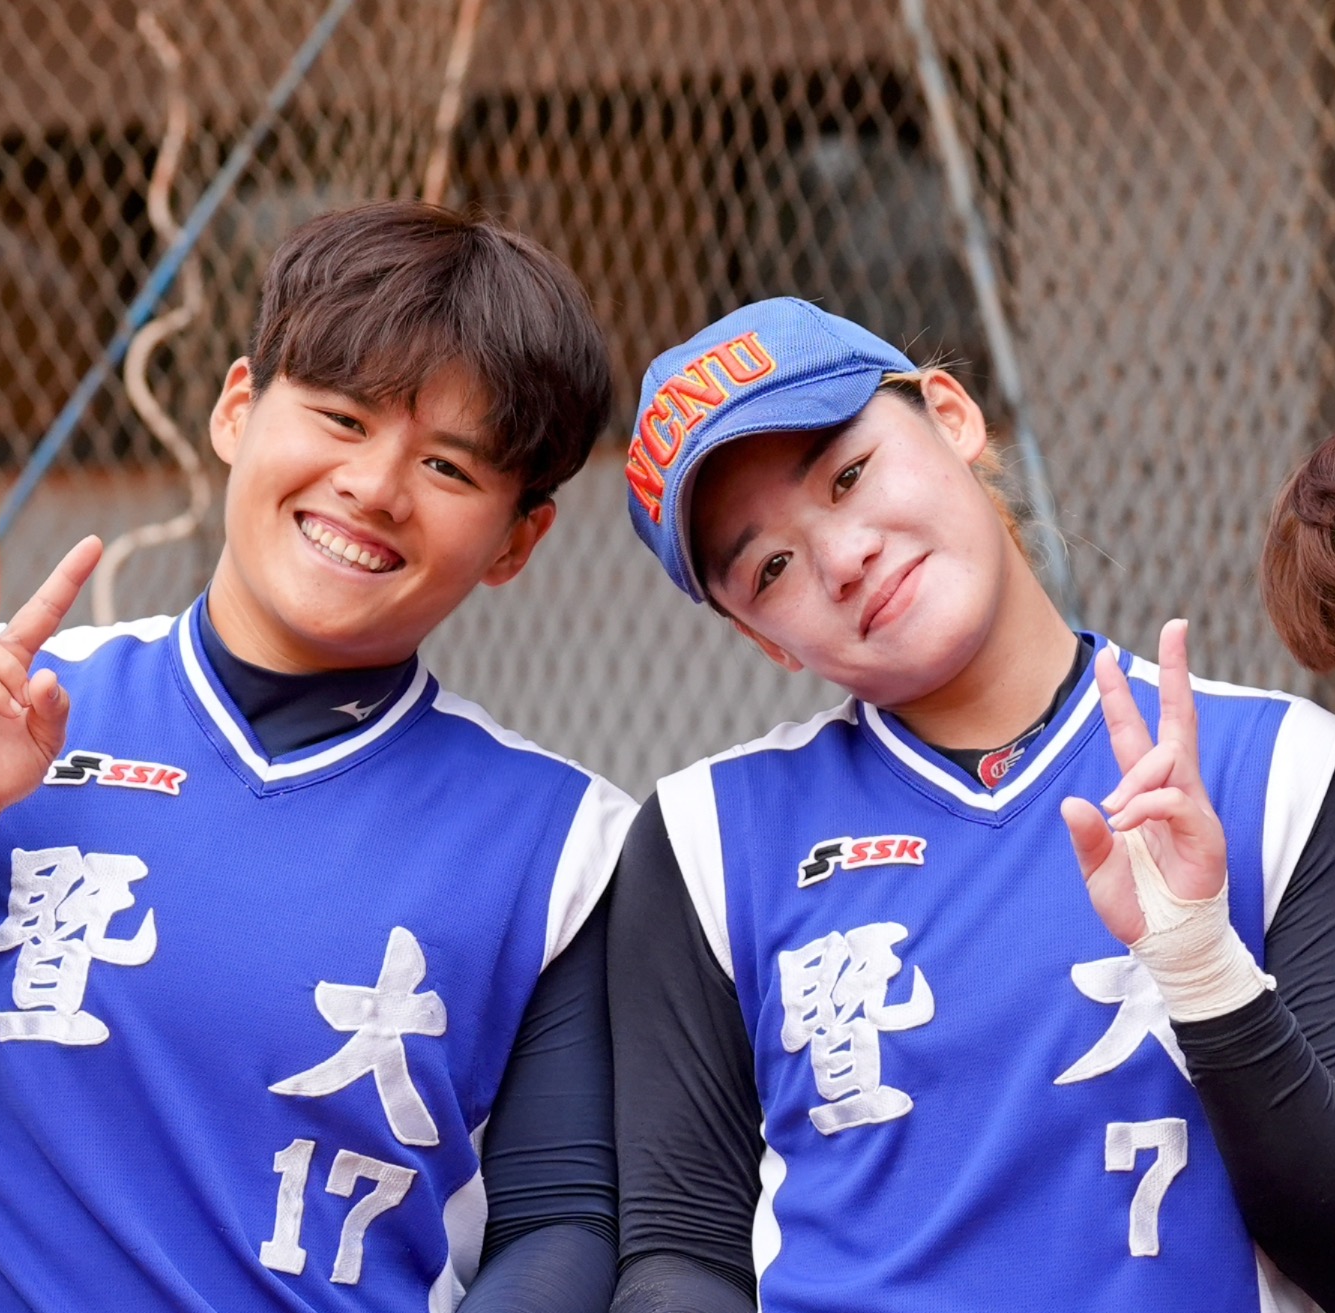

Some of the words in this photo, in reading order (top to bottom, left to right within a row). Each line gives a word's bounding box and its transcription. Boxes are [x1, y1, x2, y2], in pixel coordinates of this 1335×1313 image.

[624, 330, 777, 525] NCNU
[102, 764, 183, 793] SSK
[847, 839, 923, 864] SSK
[259, 1138, 418, 1284] 17
[1105, 1117, 1189, 1258] 7
